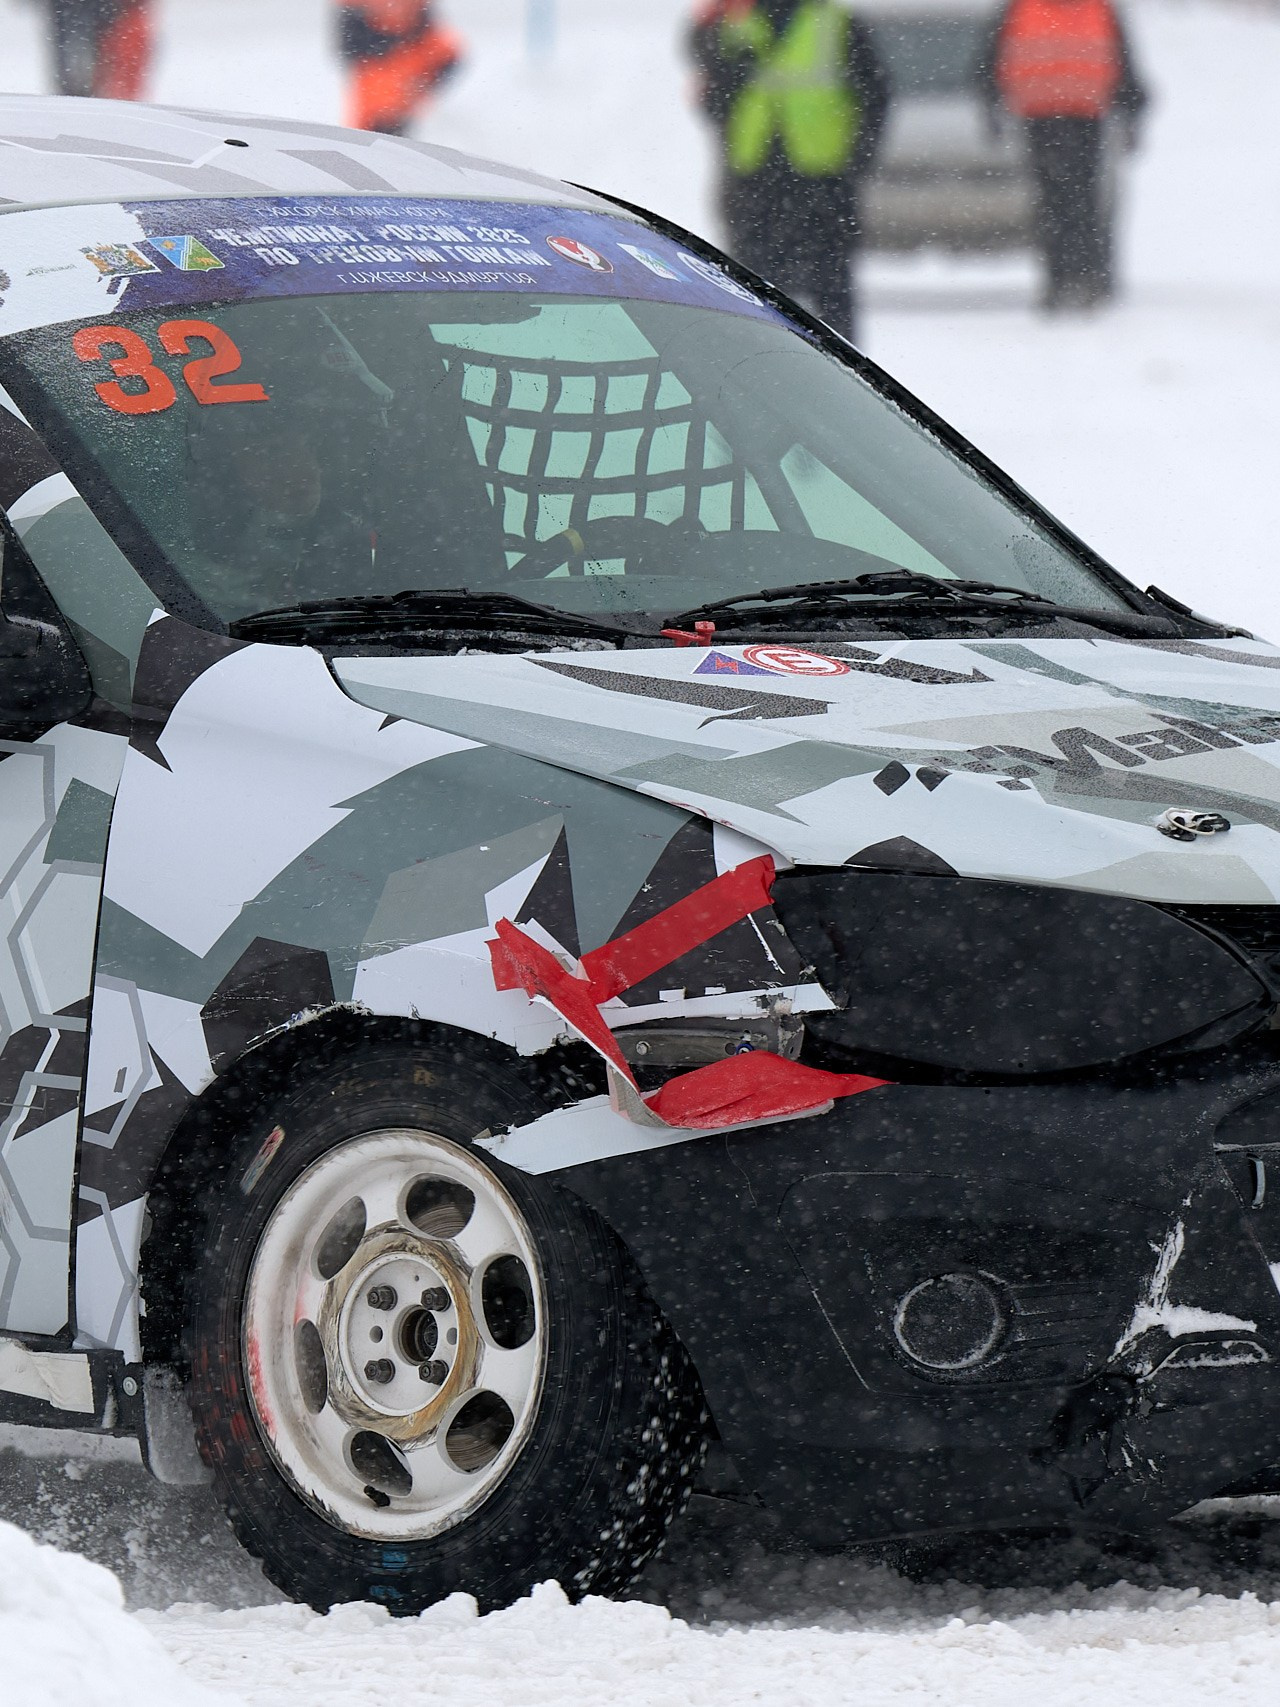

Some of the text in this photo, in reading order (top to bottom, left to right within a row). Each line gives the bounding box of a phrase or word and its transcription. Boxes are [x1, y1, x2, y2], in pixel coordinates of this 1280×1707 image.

[207, 224, 532, 247] ЧЕМПИОНАТ РОССИИ 2025
[253, 247, 300, 266] ПО
[440, 246, 553, 267] ГОНКАМ
[336, 271, 538, 285] г.ИЖЕВСК УДМУРТИЯ
[73, 319, 269, 416] 32
